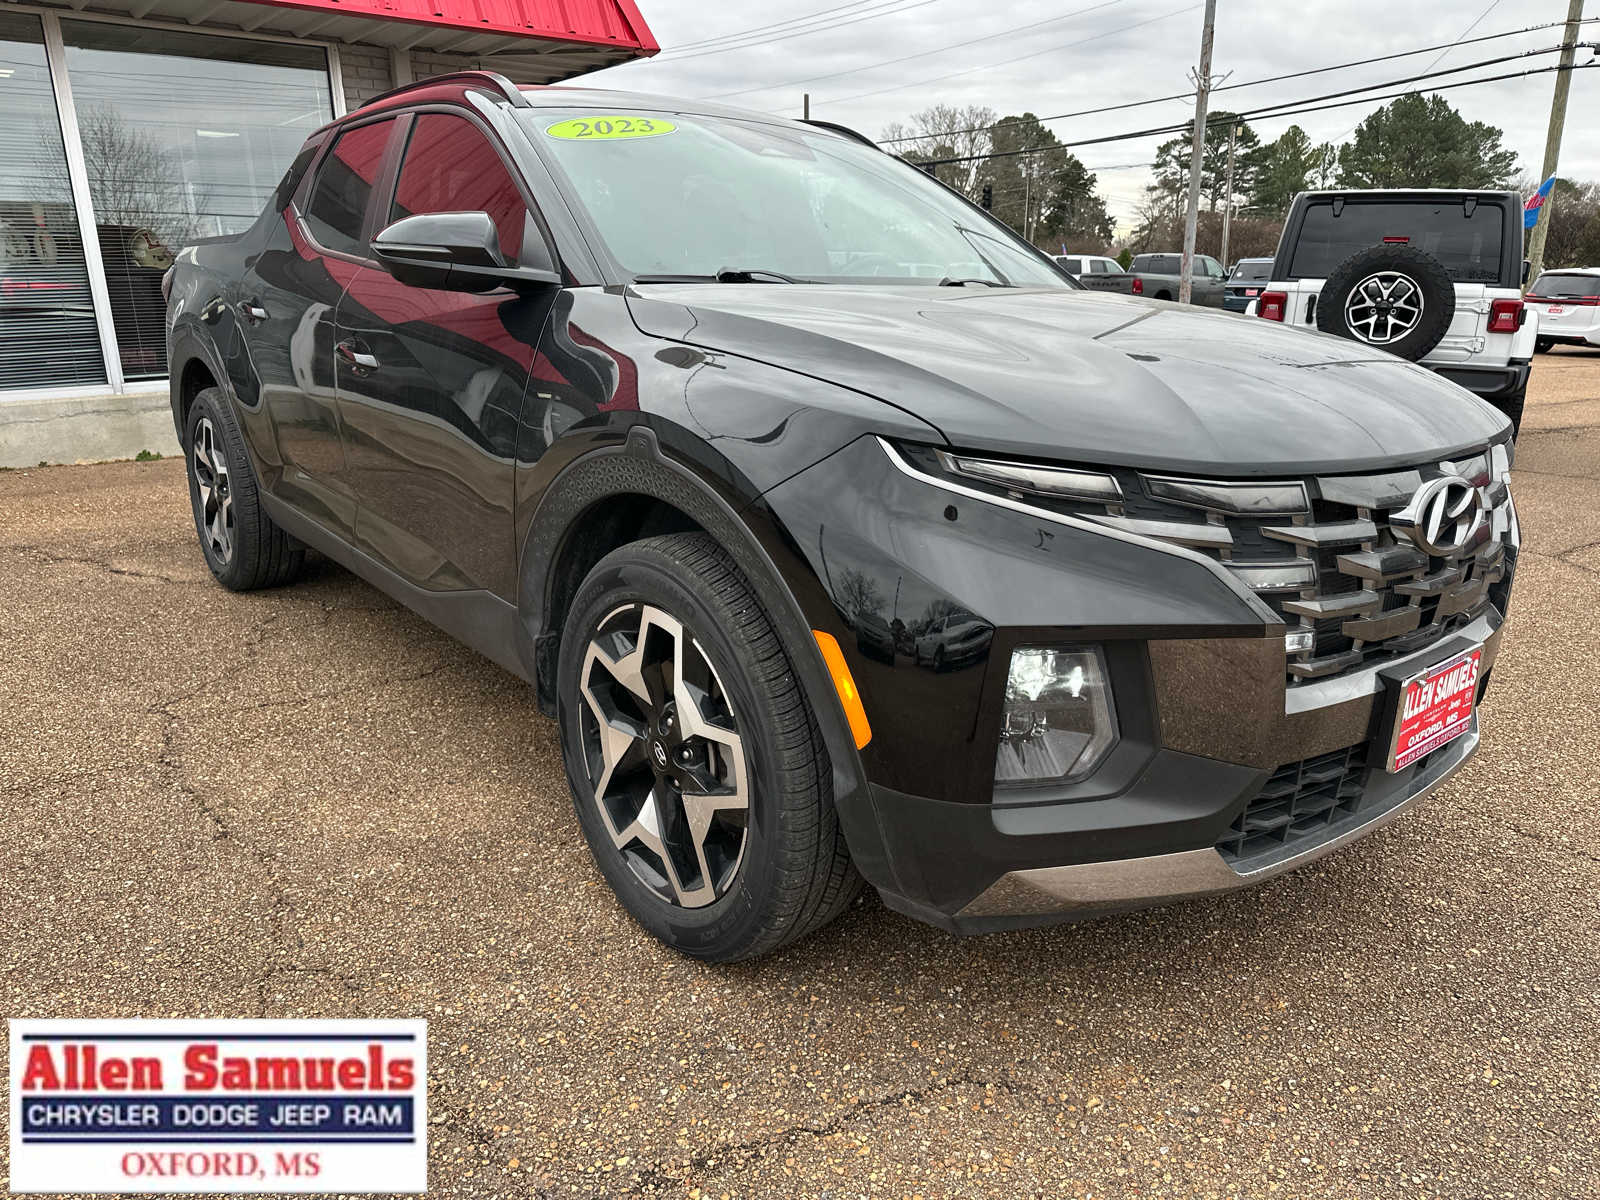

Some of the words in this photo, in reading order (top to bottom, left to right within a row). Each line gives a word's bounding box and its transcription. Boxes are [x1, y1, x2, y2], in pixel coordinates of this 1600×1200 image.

[572, 119, 655, 138] 2023
[1402, 681, 1435, 722] ALLEN
[1434, 658, 1479, 706] SAMUELS
[1407, 720, 1444, 747] OXFORD,
[1446, 711, 1459, 726] MS
[1398, 751, 1416, 767] ALLEN
